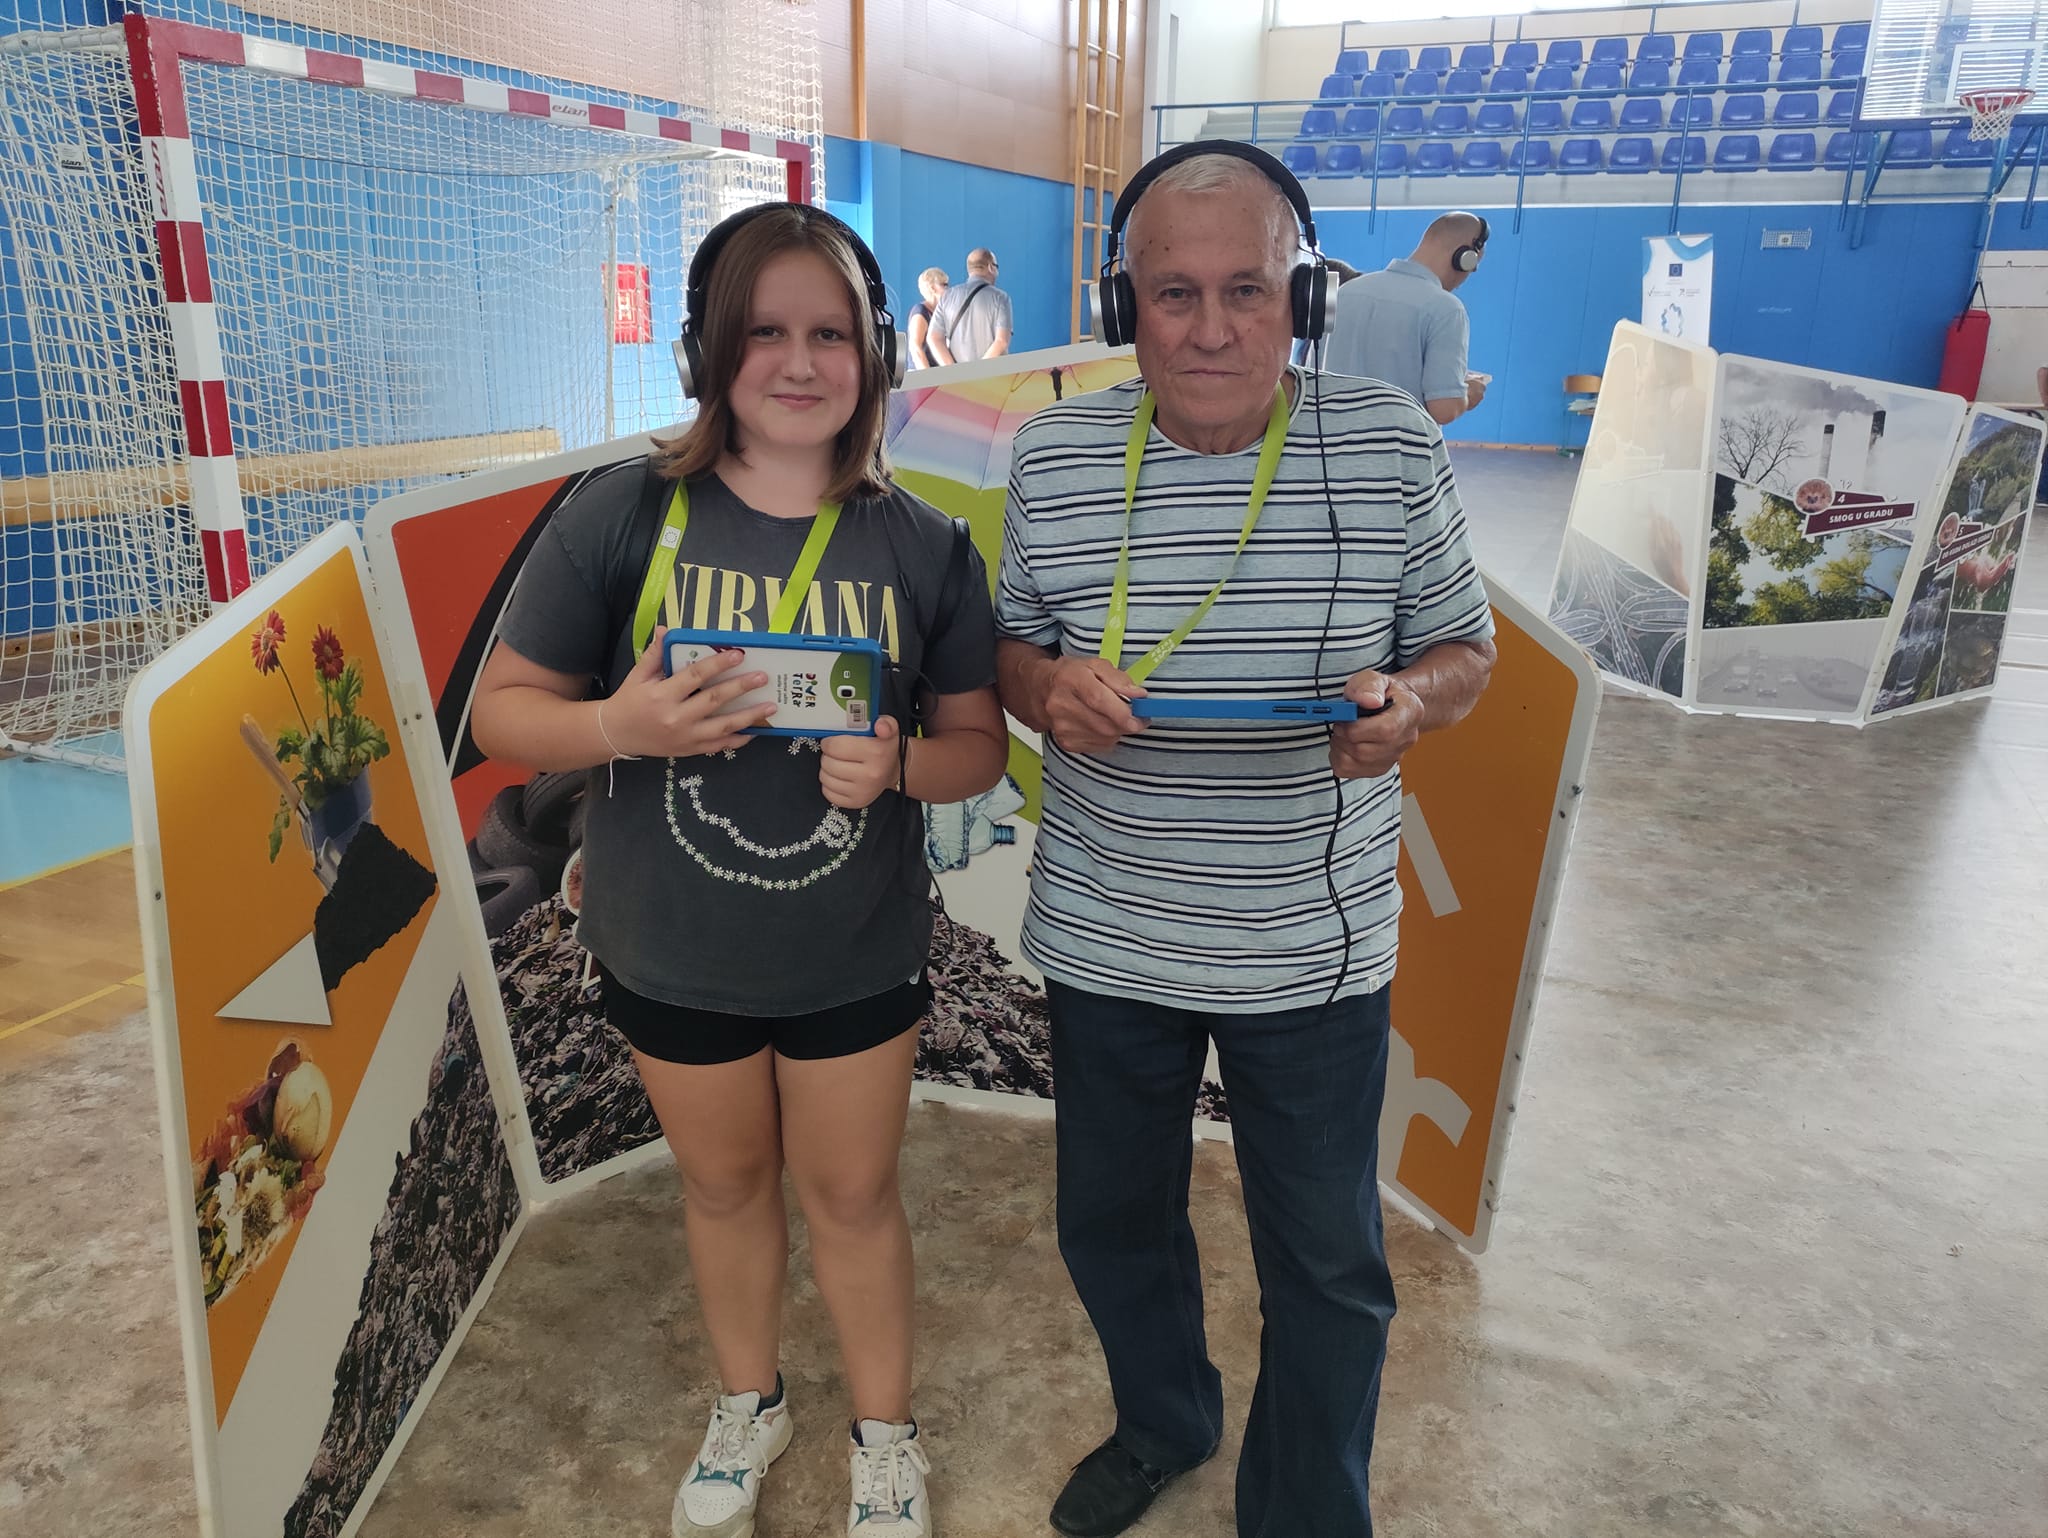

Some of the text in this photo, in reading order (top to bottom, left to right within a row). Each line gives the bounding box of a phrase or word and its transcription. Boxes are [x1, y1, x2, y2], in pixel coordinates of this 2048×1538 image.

[552, 104, 588, 117] elan
[151, 140, 168, 217] elan
[1838, 494, 1845, 504] 4
[1829, 508, 1894, 524] SMOG U GRADU
[1958, 526, 1965, 537] 5
[654, 563, 900, 666] NIRVANA
